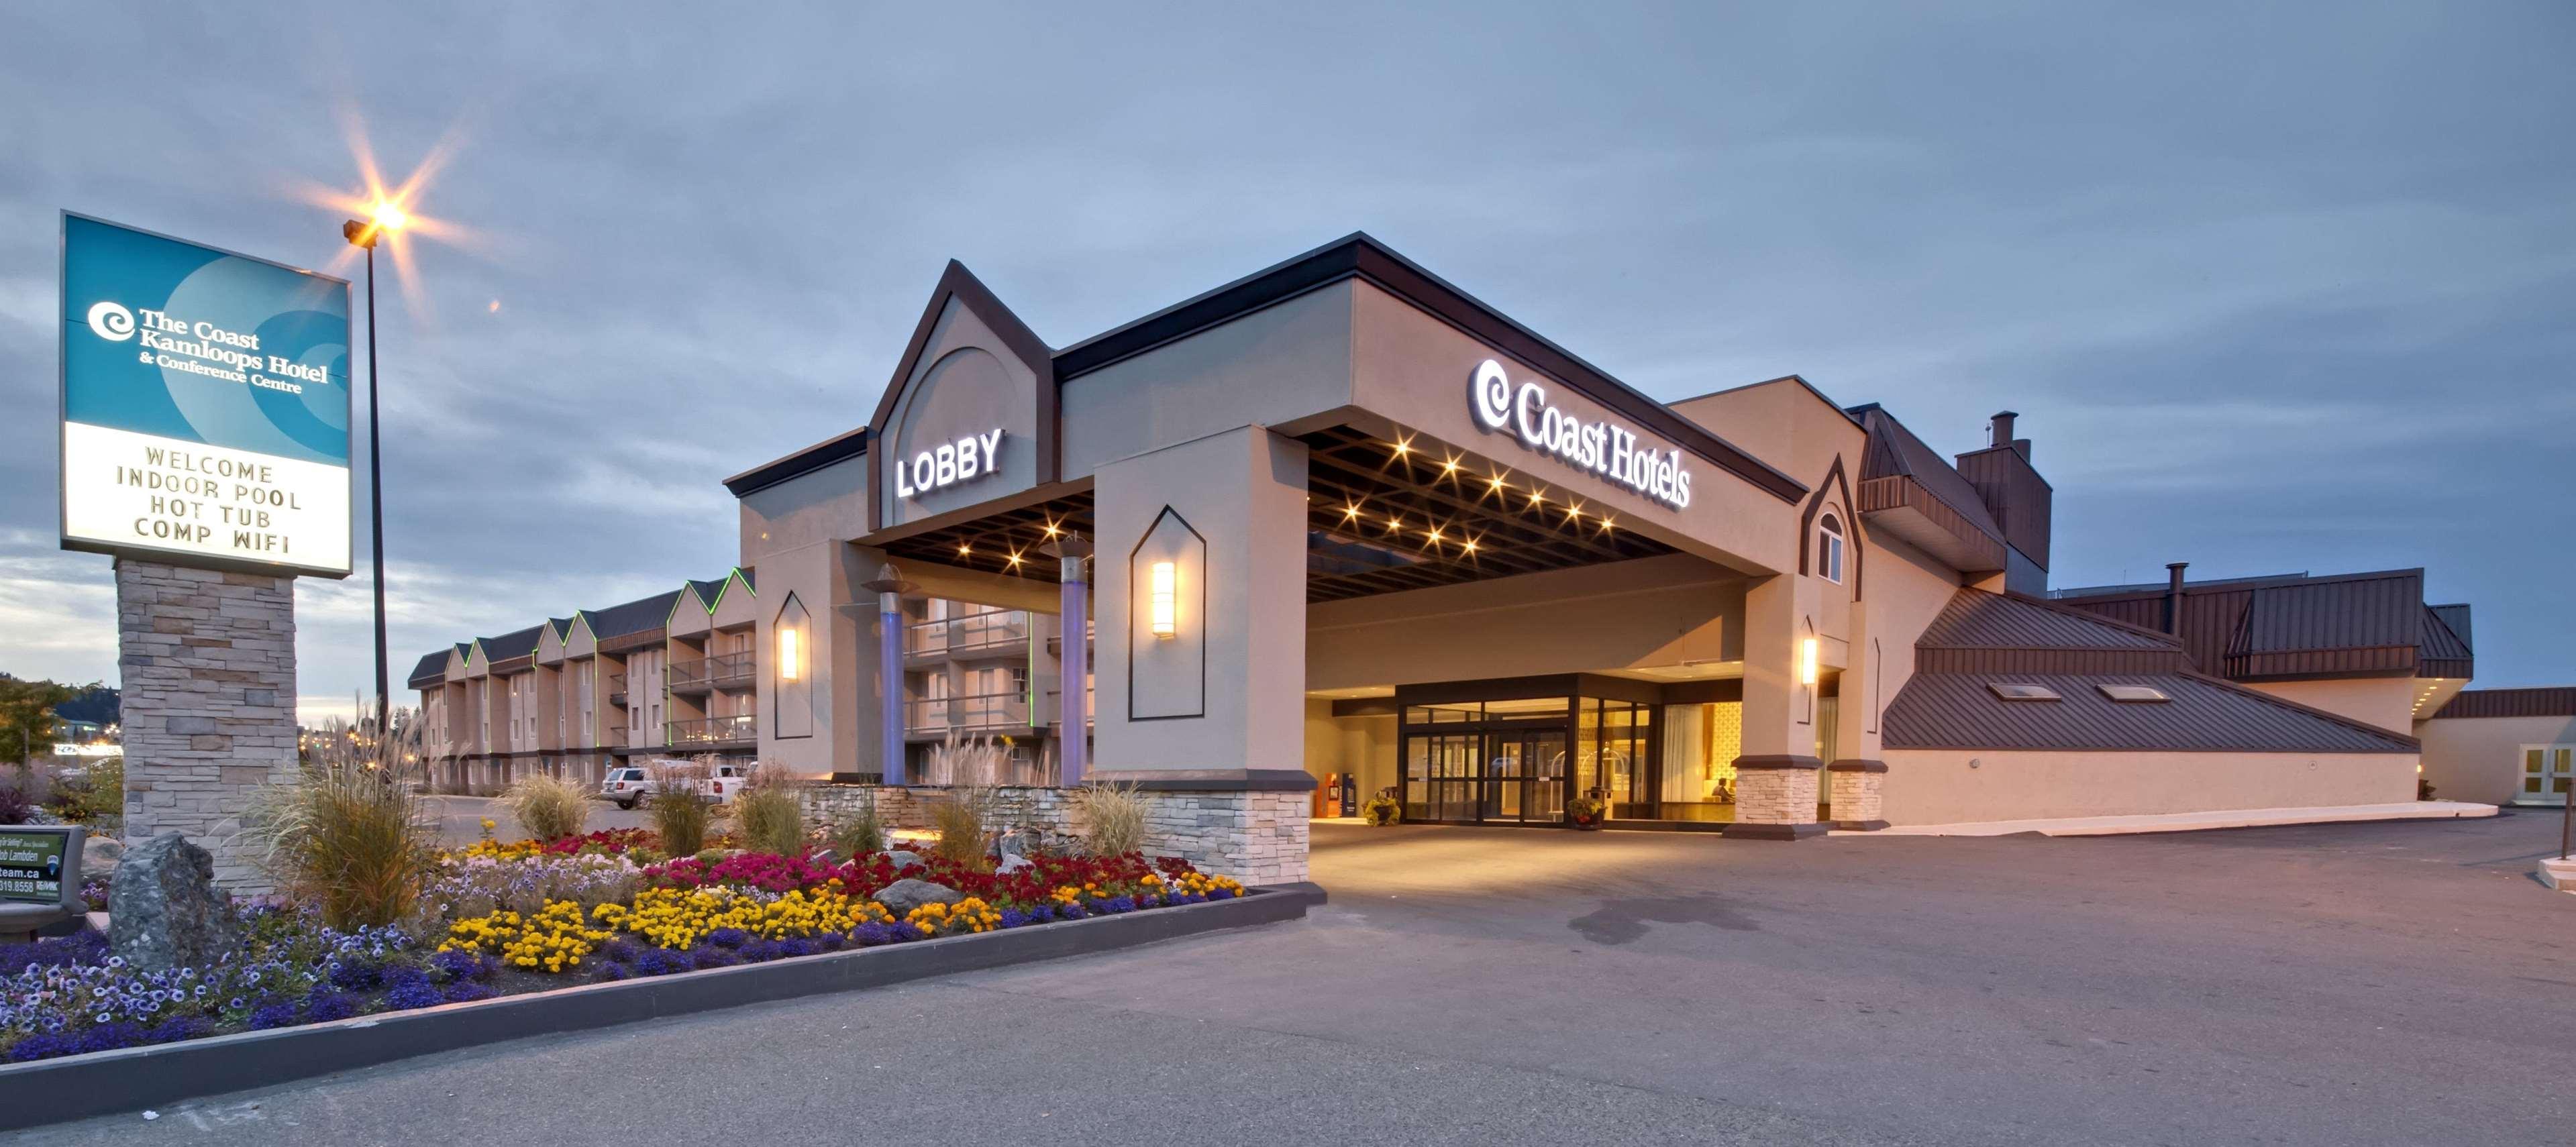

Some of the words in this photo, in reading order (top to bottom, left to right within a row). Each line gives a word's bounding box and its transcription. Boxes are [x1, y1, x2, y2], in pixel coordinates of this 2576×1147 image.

[139, 309, 188, 335] The
[194, 322, 260, 350] Coast
[139, 328, 264, 373] Kamloops
[268, 356, 329, 384] Hotel
[139, 351, 155, 365] &
[156, 355, 248, 384] Conference
[250, 374, 302, 394] Centre
[145, 445, 272, 484] WELCOME
[897, 428, 1002, 498] LOBBY
[1517, 382, 1608, 474] Coast
[1609, 423, 1690, 508] Hotels
[116, 465, 219, 498] INDOOR
[234, 484, 301, 510] POOL
[150, 495, 204, 520] HOT
[219, 504, 270, 529] TUB
[134, 517, 211, 543] COMP
[234, 529, 289, 554] WIFI
[9, 850, 38, 862] Lambden
